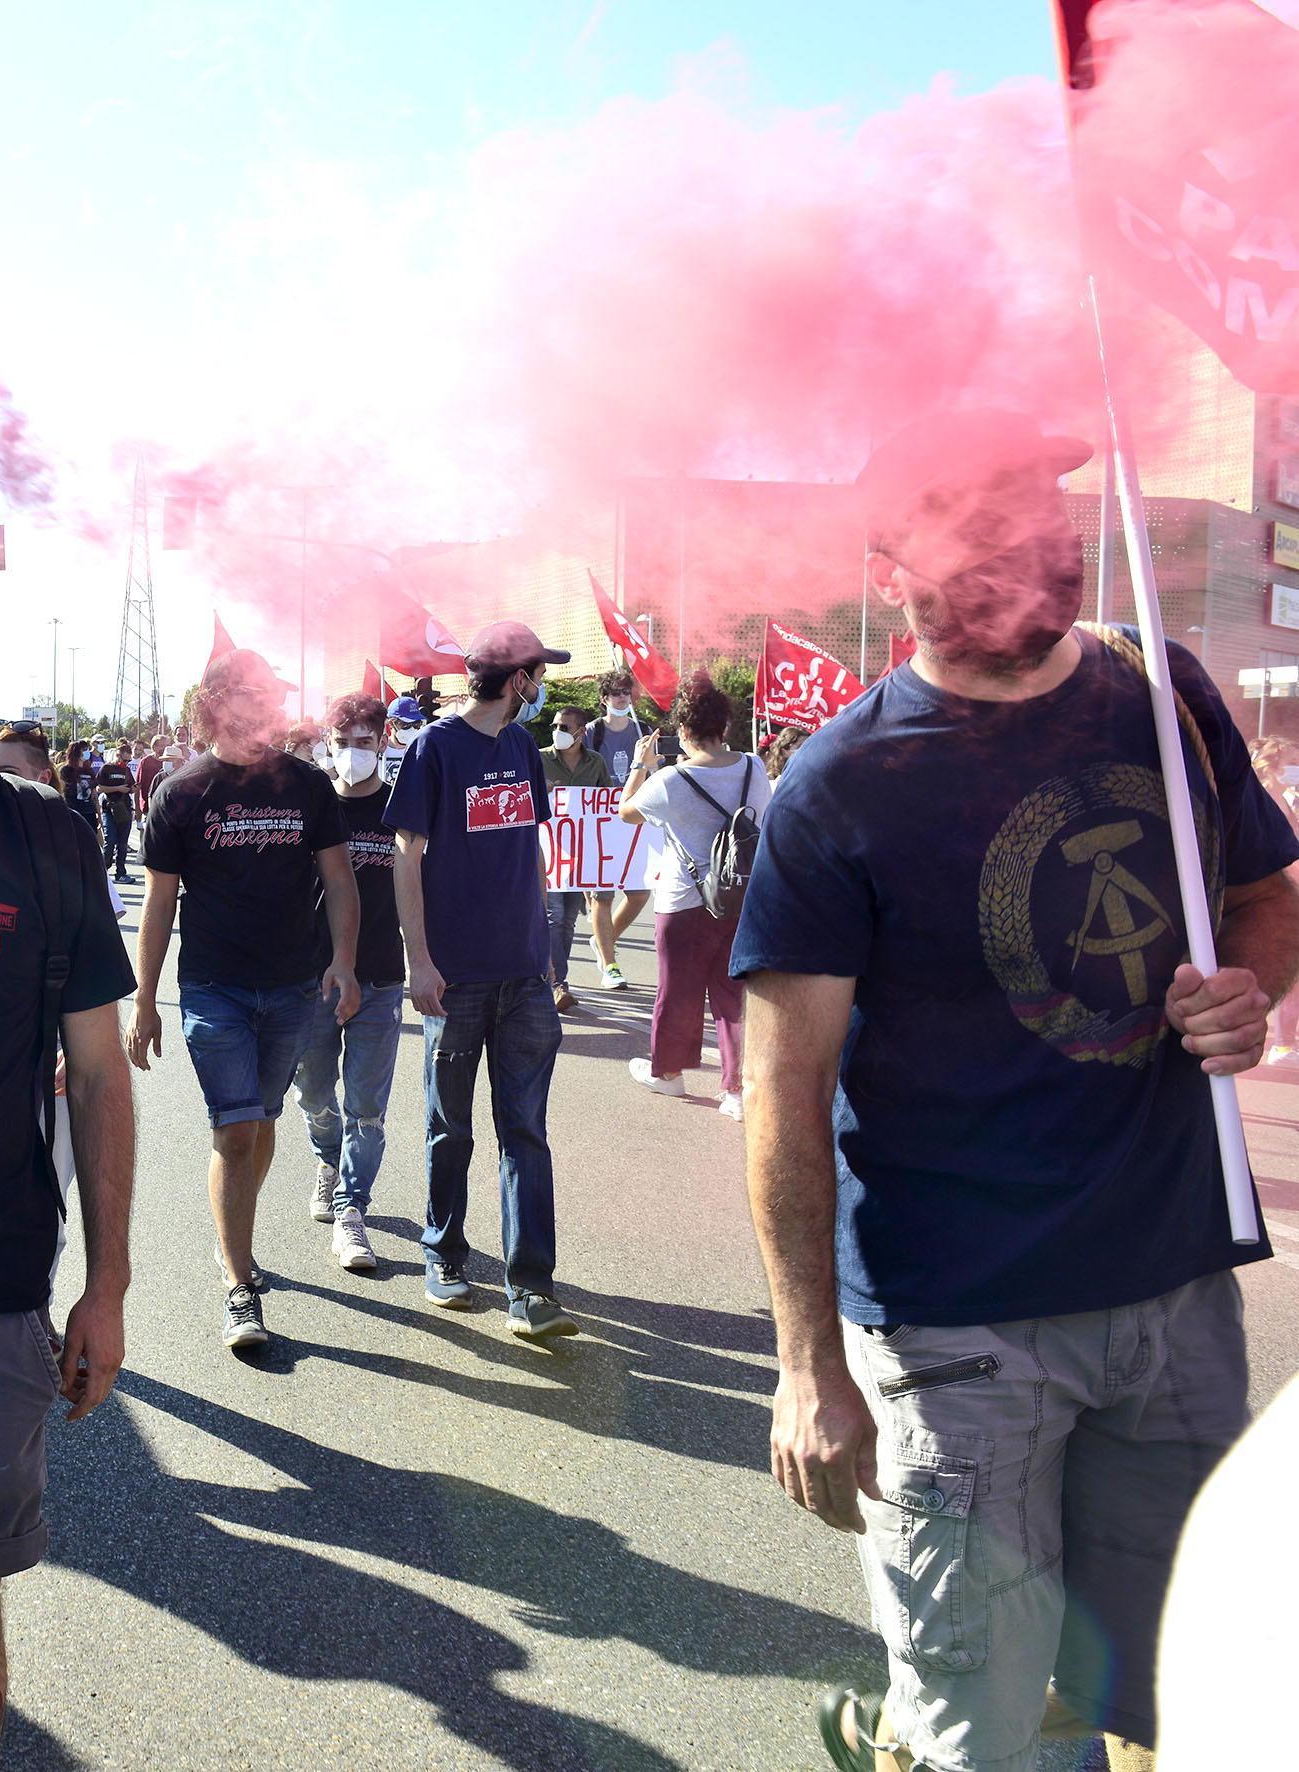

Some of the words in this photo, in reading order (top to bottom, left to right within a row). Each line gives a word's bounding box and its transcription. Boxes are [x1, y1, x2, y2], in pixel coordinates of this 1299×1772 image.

[483, 772, 498, 781] 1917
[503, 770, 516, 779] 2017
[225, 803, 303, 820] Resistenza
[581, 787, 623, 816] MAS
[204, 822, 303, 853] Insegna
